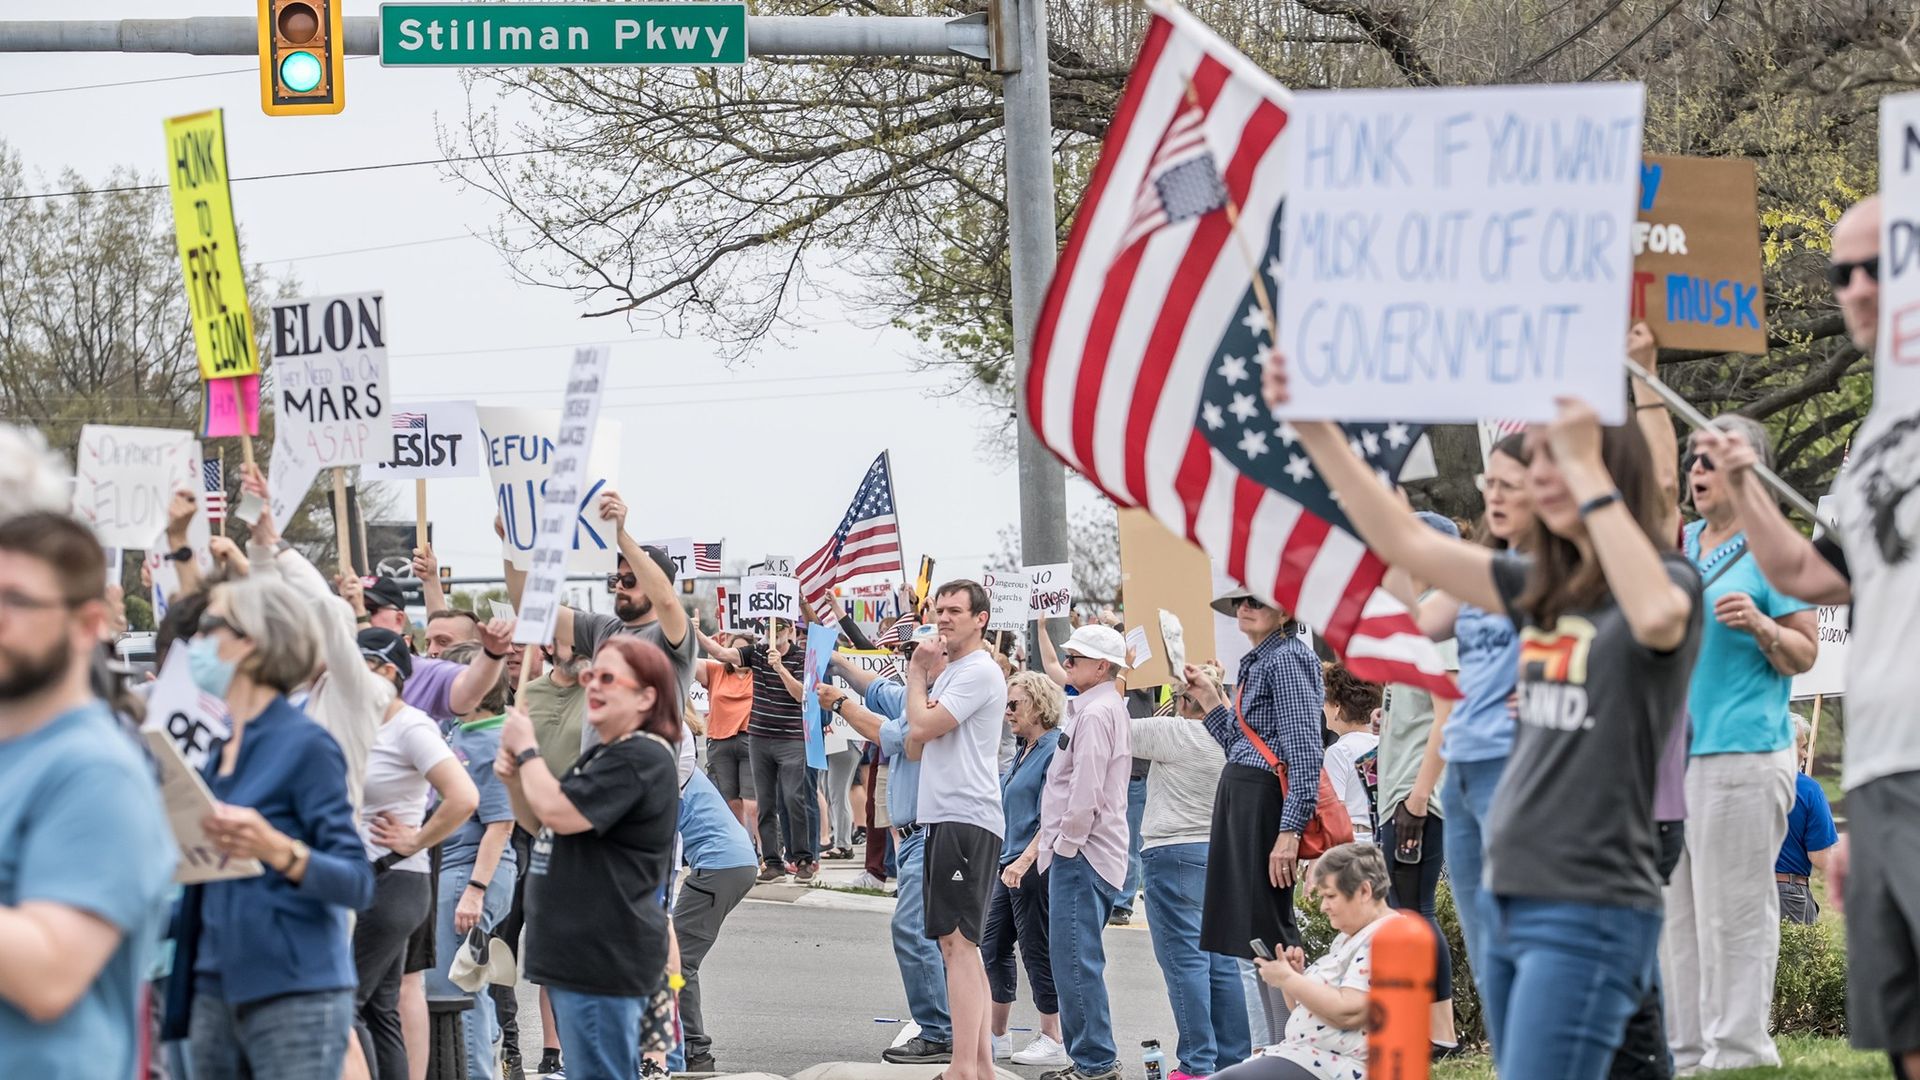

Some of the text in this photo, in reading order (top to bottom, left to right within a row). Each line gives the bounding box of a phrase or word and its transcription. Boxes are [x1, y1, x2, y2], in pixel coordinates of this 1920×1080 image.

[398, 19, 729, 58] Stillman Pkwy
[173, 129, 220, 191] HONK
[1305, 111, 1413, 190] HONK
[1485, 111, 1543, 189] YOU
[1550, 114, 1637, 185] WANT
[195, 200, 212, 238] TO
[1632, 221, 1688, 256] FOR
[1288, 208, 1618, 283] MUSK OUT OF OUR
[188, 242, 227, 321] FIRE
[1666, 273, 1760, 329] MUSK
[209, 312, 251, 372] ELON
[272, 296, 385, 358] ELON
[1297, 299, 1583, 387] GOVERNMENT
[304, 358, 333, 387] NEED
[359, 353, 380, 381] ON
[284, 383, 382, 423] MARS
[307, 423, 369, 463] ASAP
[379, 431, 463, 469] ESIST
[94, 467, 174, 529] ELON
[498, 478, 608, 551] MUK
[983, 574, 1029, 589] Dangerous
[1030, 588, 1070, 615] ings
[749, 591, 793, 613] RESIST
[845, 599, 887, 623] HONK
[991, 605, 1004, 614] rab
[1818, 605, 1839, 623] MY
